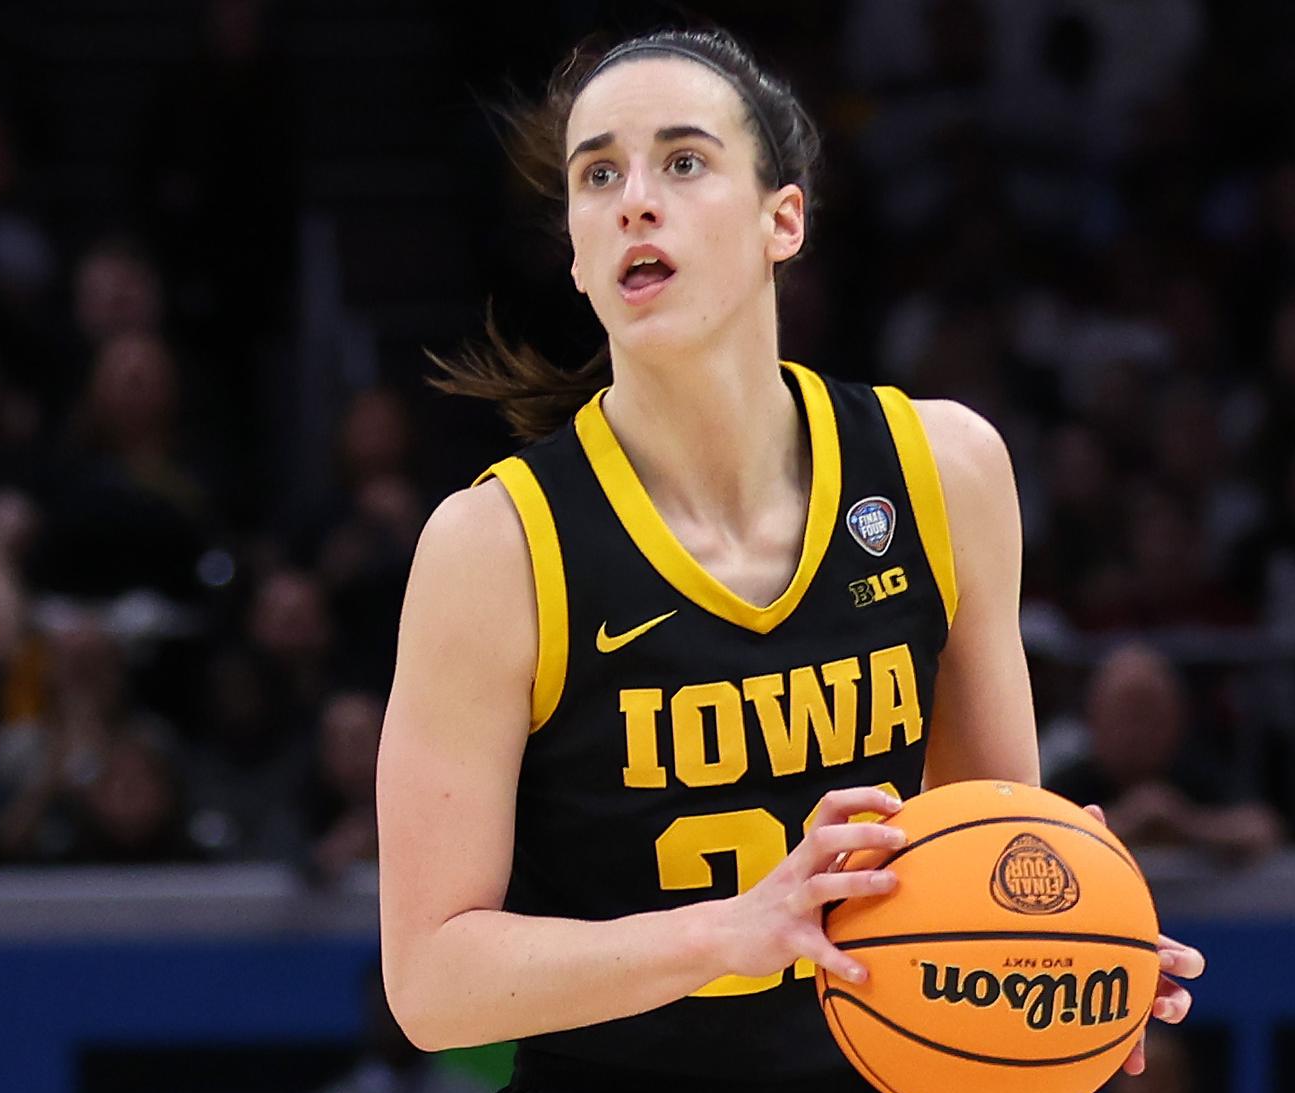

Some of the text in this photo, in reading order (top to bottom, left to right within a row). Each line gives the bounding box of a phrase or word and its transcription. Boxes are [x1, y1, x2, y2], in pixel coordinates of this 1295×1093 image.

[858, 510, 885, 526] FINAL
[861, 521, 888, 539] FOUR
[619, 643, 924, 789] IOWA
[1008, 859, 1059, 878] FOUR
[1009, 878, 1061, 895] FINAL
[1002, 957, 1074, 968] EVO NXT
[919, 962, 1130, 1031] Wilson
